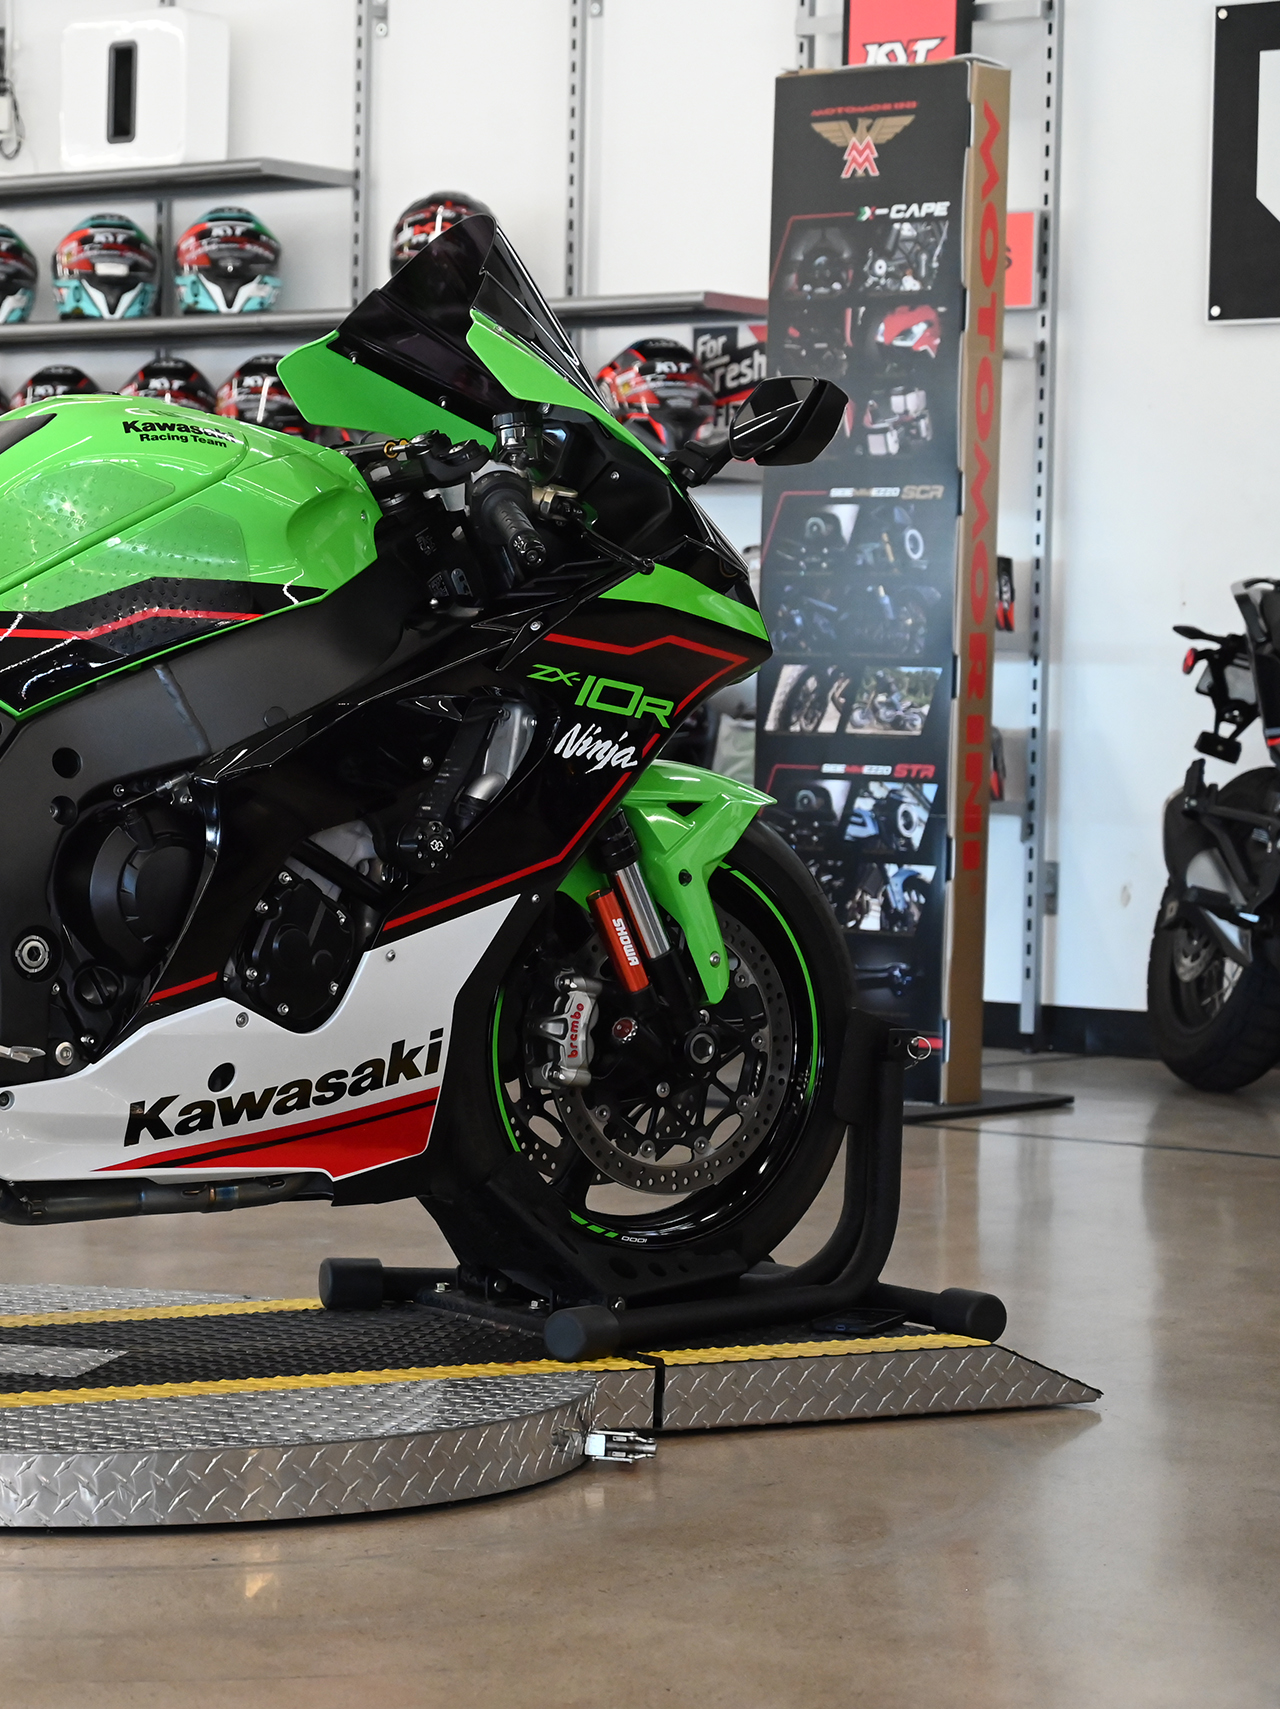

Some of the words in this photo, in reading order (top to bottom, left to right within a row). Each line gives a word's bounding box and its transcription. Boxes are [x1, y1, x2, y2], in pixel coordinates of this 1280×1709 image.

[654, 361, 692, 373] KYT
[696, 333, 728, 360] For
[140, 433, 189, 443] Racing
[190, 435, 228, 448] Team
[527, 663, 675, 729] ZX-10R
[554, 723, 638, 774] Ninja
[612, 918, 640, 967] SHOWA
[567, 1003, 585, 1059] brembo
[123, 1027, 444, 1148] Kawasaki
